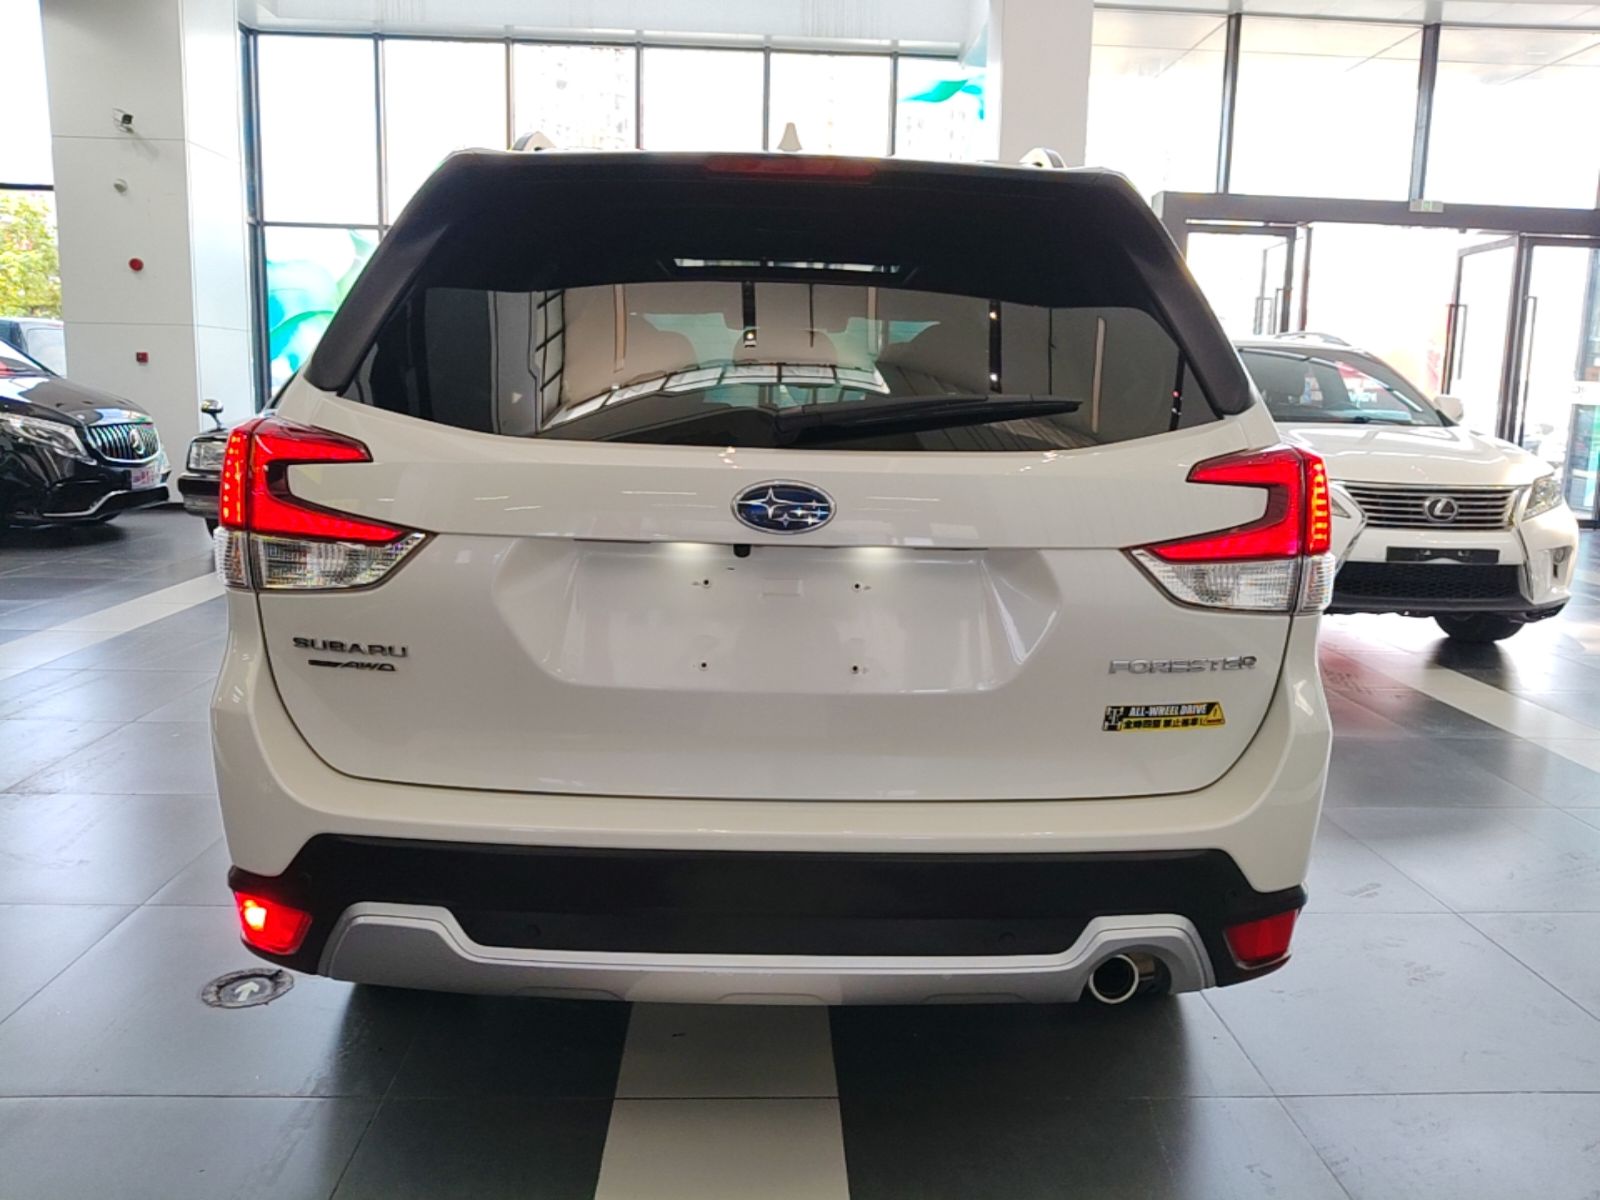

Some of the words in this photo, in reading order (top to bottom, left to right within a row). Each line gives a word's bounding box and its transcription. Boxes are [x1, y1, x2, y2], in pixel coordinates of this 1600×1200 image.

[293, 637, 408, 658] SUBARU
[340, 661, 396, 672] AWD
[1108, 655, 1257, 674] FORESTER
[1128, 706, 1179, 717] ALL-WHEEL
[1180, 704, 1207, 716] DRIVE
